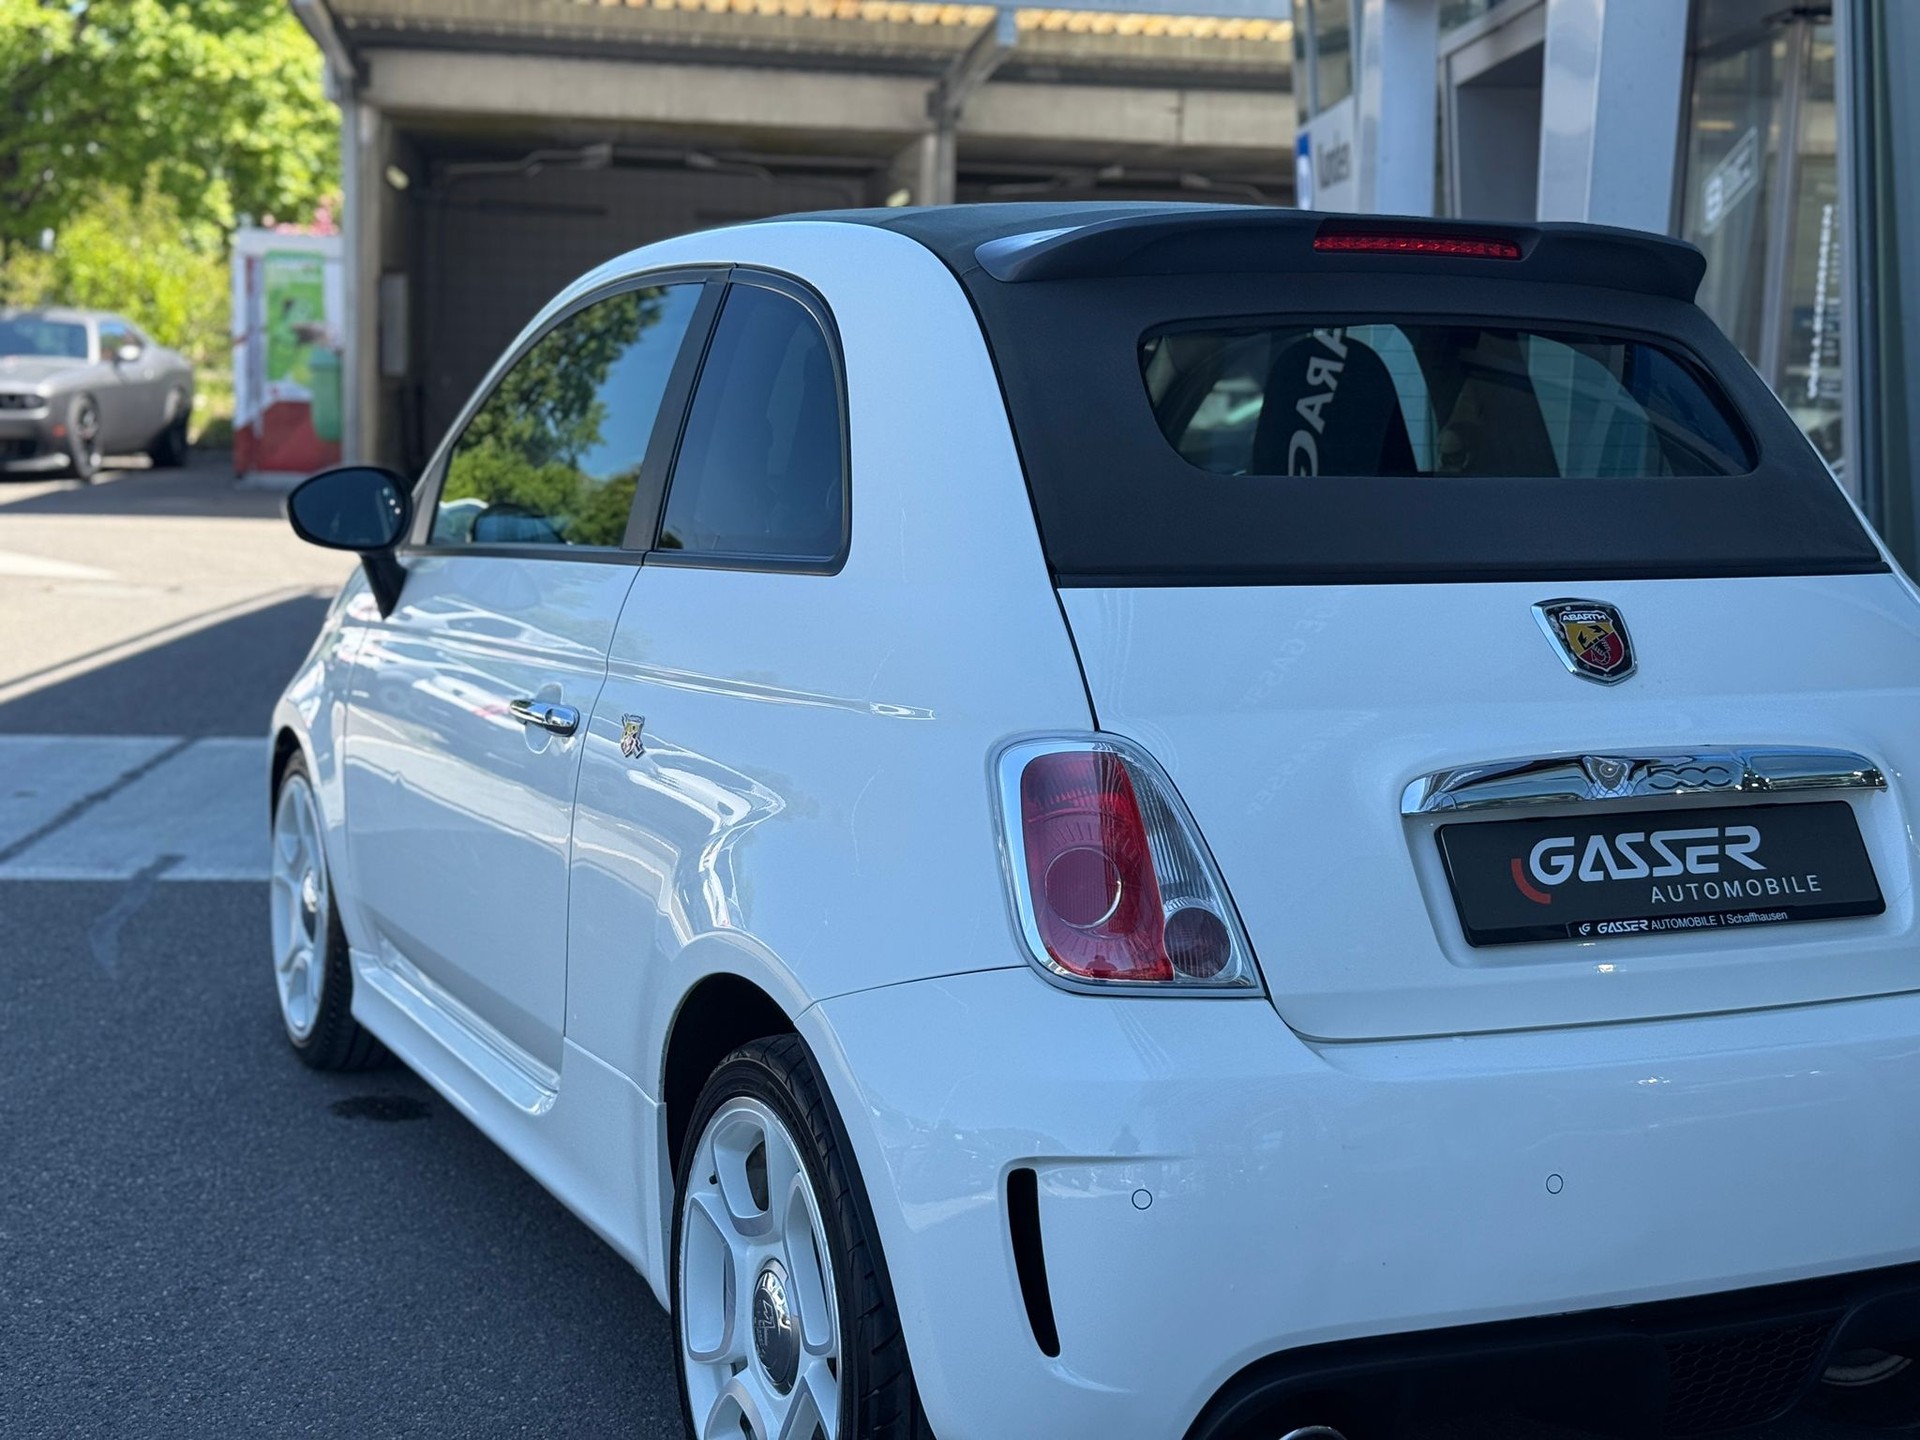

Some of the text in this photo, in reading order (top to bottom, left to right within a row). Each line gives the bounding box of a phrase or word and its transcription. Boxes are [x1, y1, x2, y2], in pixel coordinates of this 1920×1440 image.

[1562, 613, 1606, 621] ABARTH
[1529, 825, 1767, 886] GASSER
[1651, 874, 1822, 903] AUTOMOBILE
[1597, 919, 1649, 934] GASSER
[1651, 915, 1718, 930] AUTOMOBILE
[1726, 911, 1788, 924] Schaffhausen
